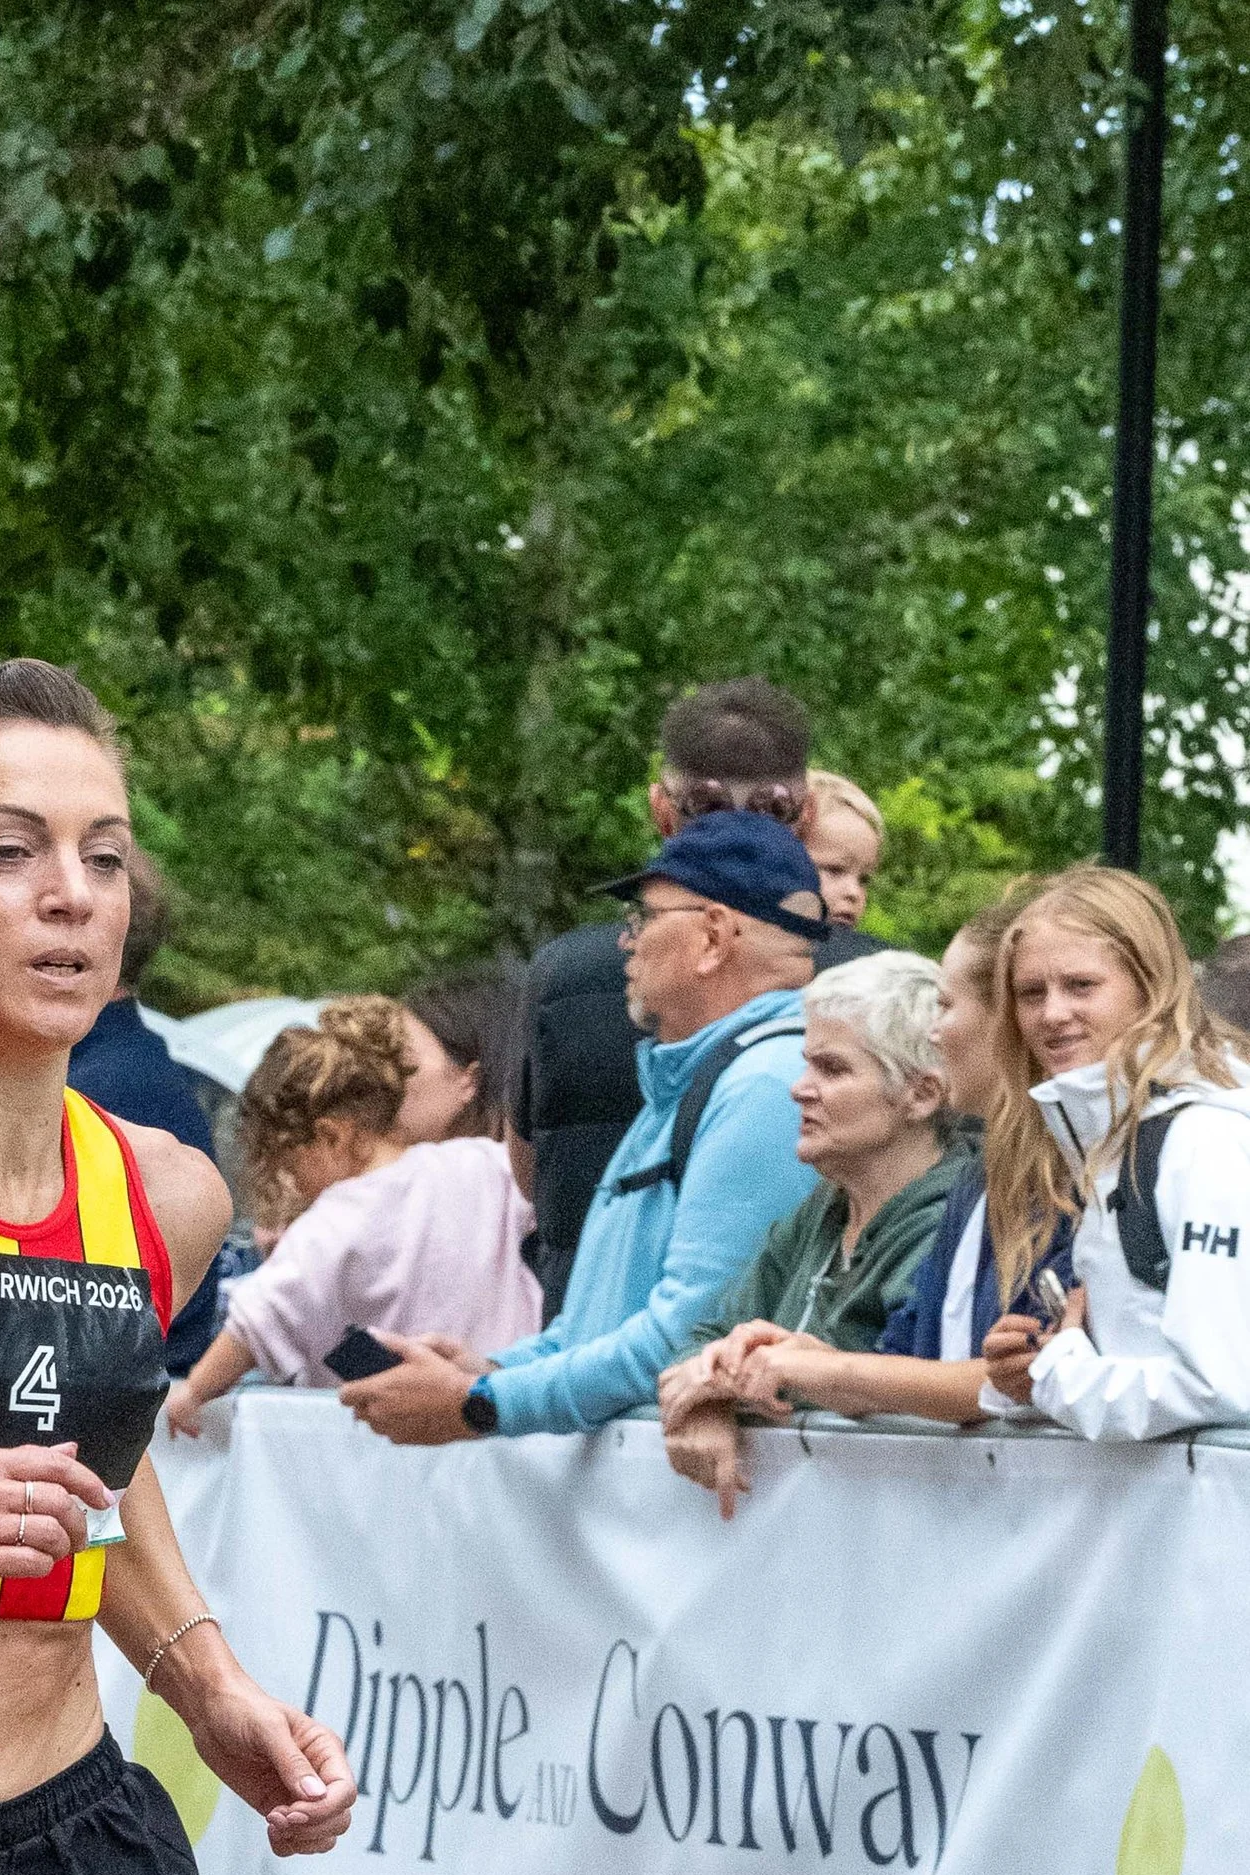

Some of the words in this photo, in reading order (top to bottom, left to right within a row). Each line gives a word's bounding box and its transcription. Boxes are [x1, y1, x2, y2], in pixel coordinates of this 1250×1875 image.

[1182, 1221, 1240, 1258] HH
[9, 1345, 61, 1431] 4
[304, 1610, 530, 1862] Dipple
